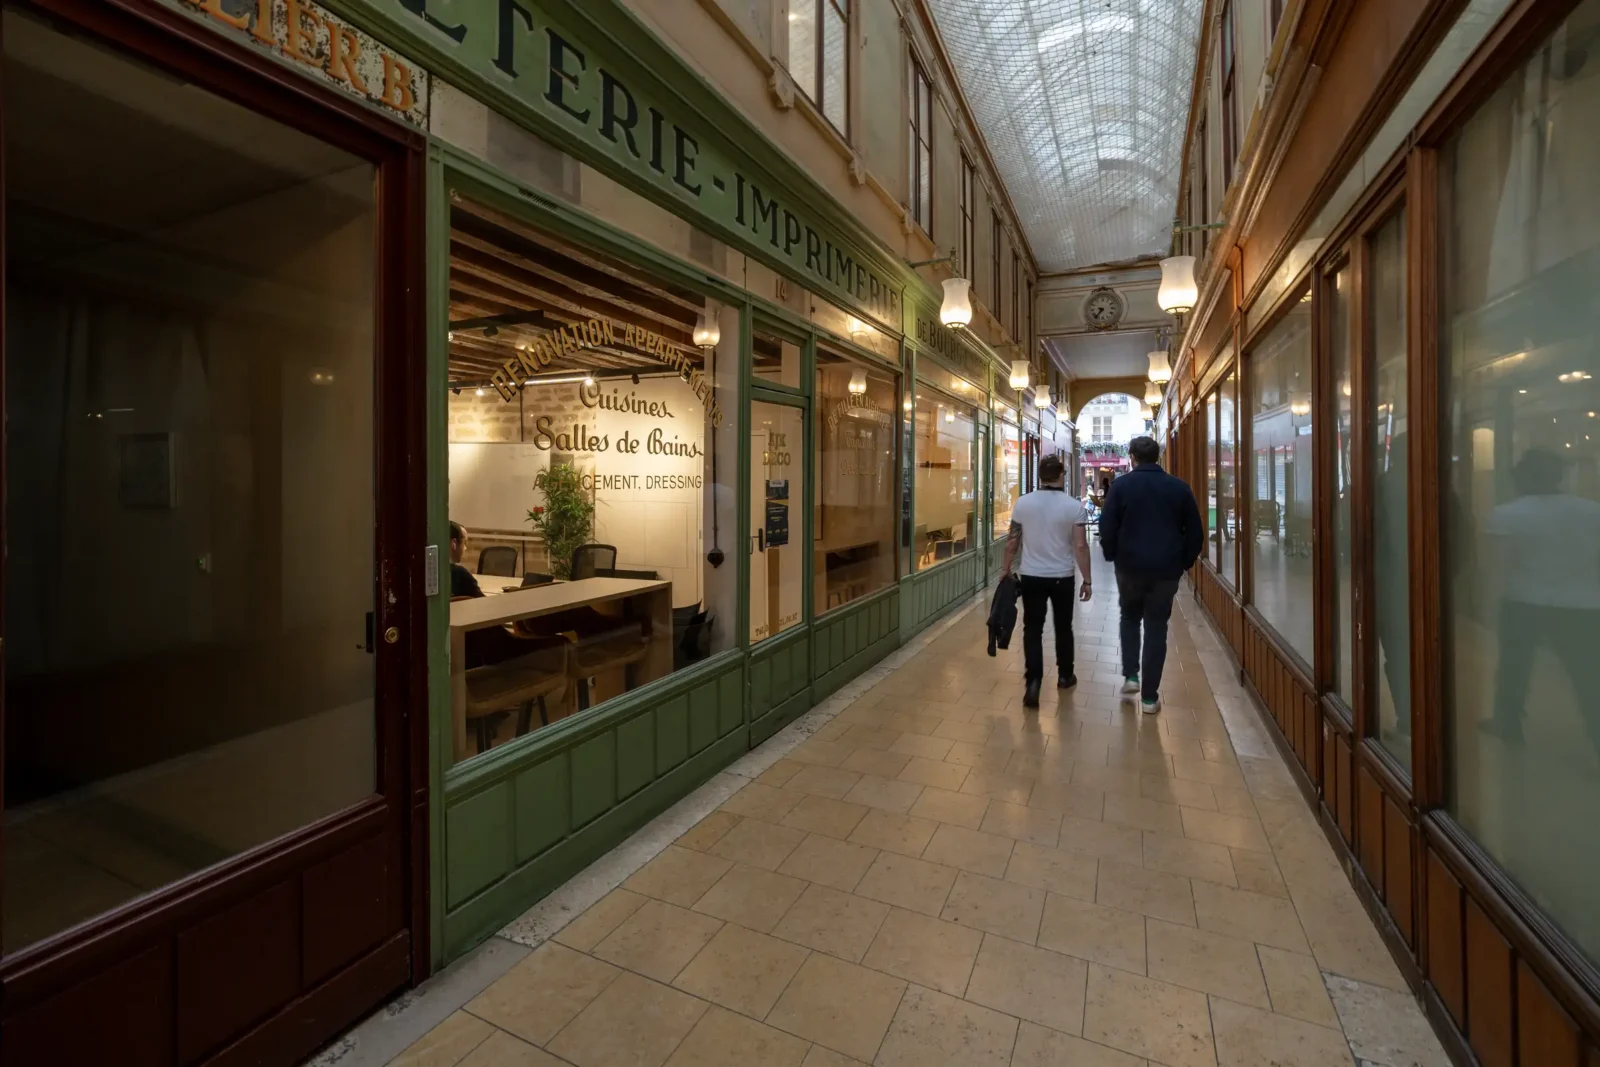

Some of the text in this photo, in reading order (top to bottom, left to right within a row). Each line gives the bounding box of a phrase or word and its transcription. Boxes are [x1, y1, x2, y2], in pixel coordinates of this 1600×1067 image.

[186, 0, 415, 112] LIER B
[490, 318, 724, 429] RENOVATION APPARTEMENTS
[579, 379, 675, 419] Cuisines
[533, 416, 705, 459] Salles de Bains
[646, 475, 702, 490] DRESSING
